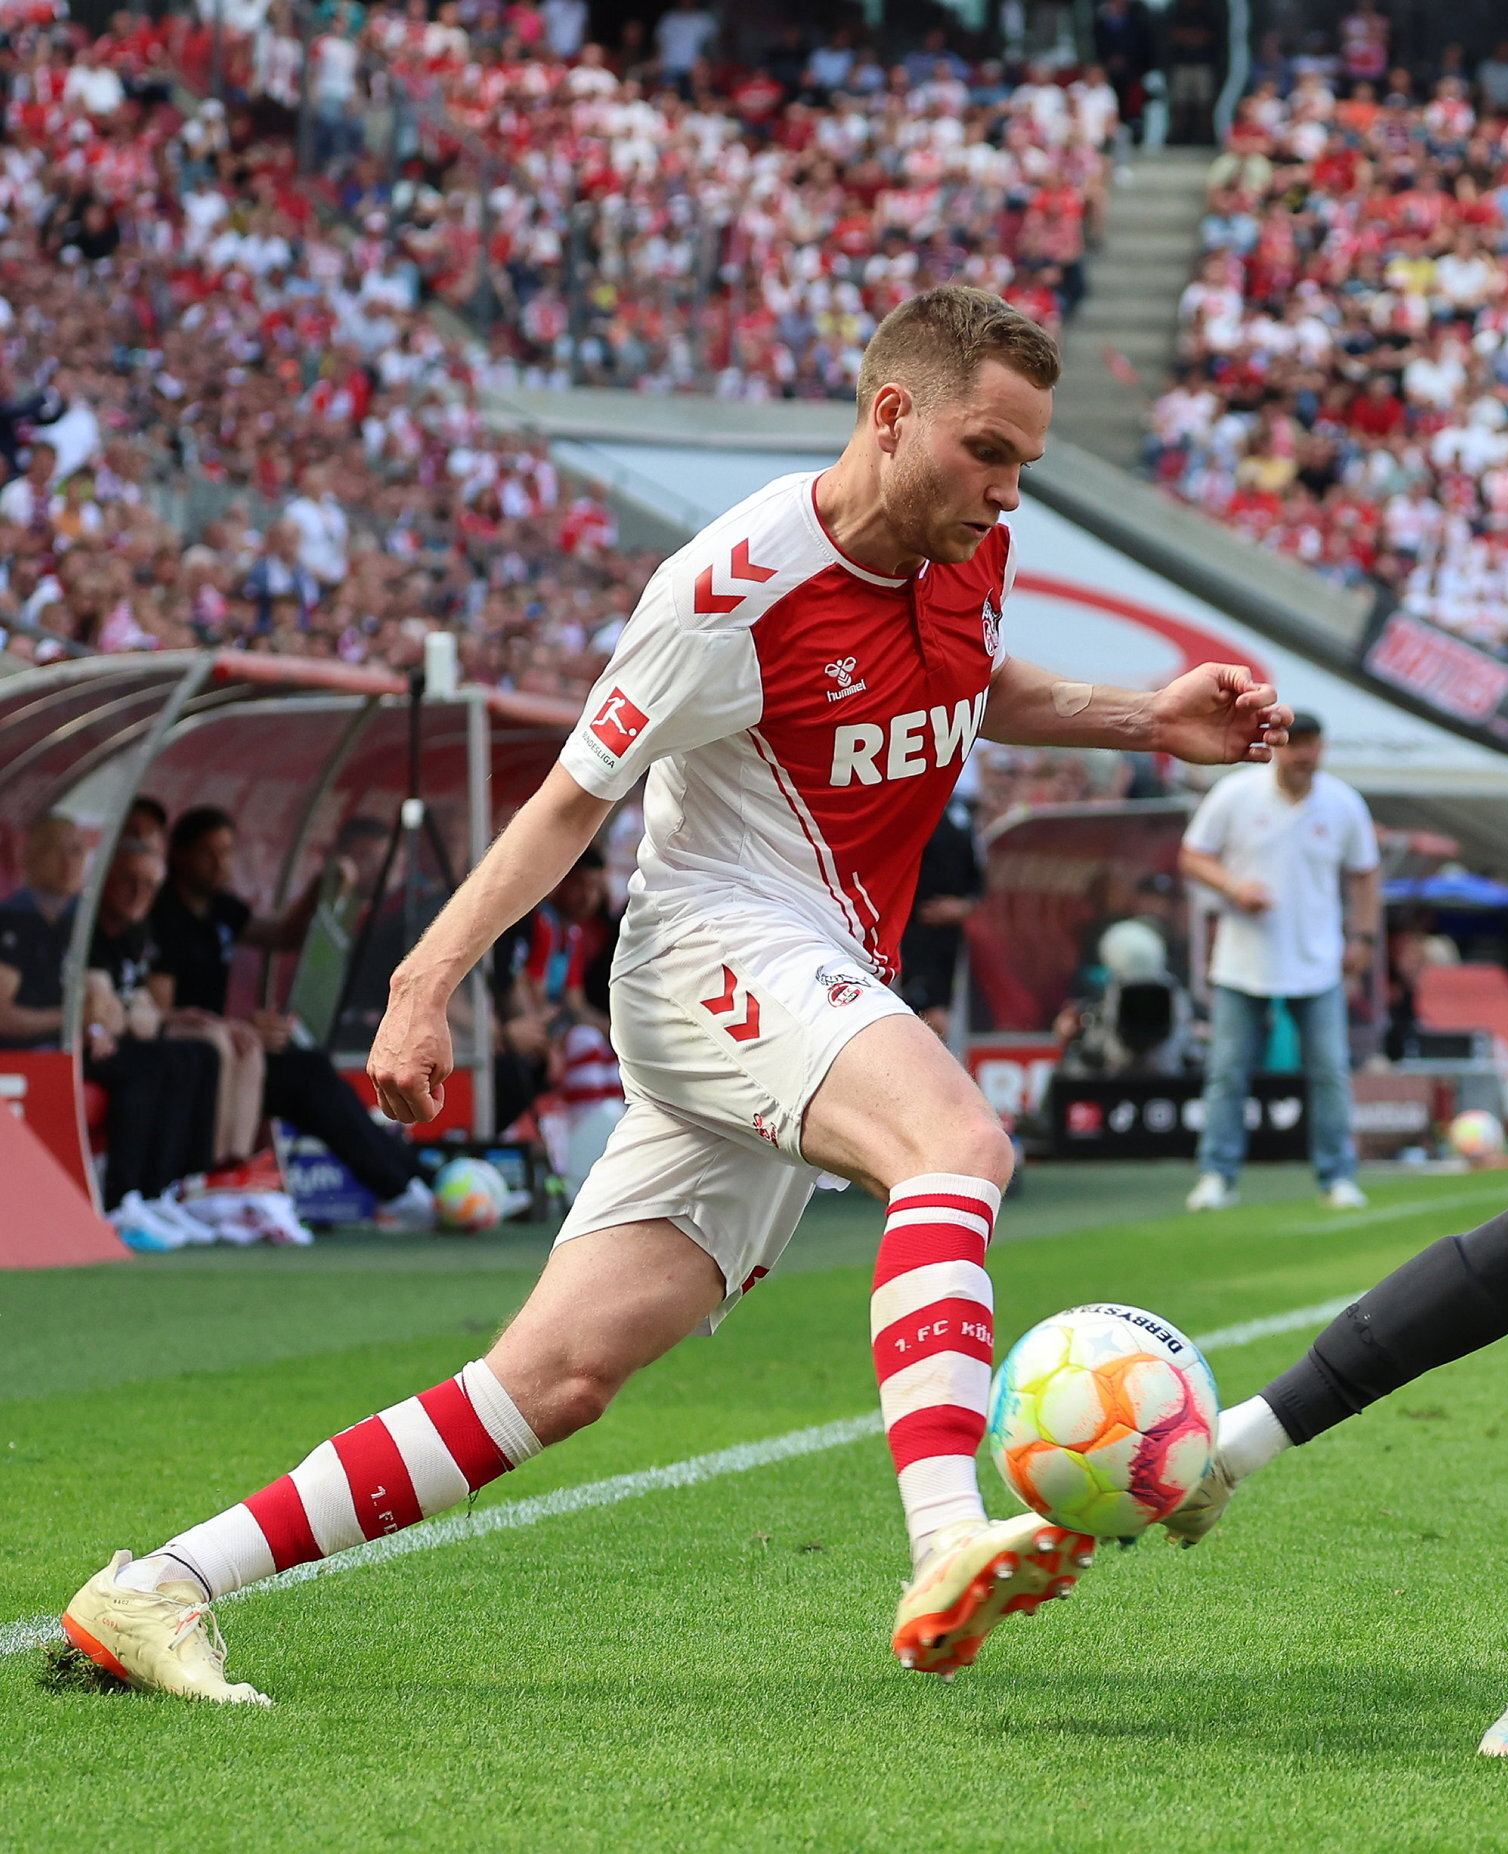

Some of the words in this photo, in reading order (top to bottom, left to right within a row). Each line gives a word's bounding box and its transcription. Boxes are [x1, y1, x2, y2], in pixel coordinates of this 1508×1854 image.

[826, 678, 867, 703] hummel
[581, 730, 615, 769] BUNDESLIGA
[829, 685, 990, 787] REW
[917, 1320, 949, 1342] FC
